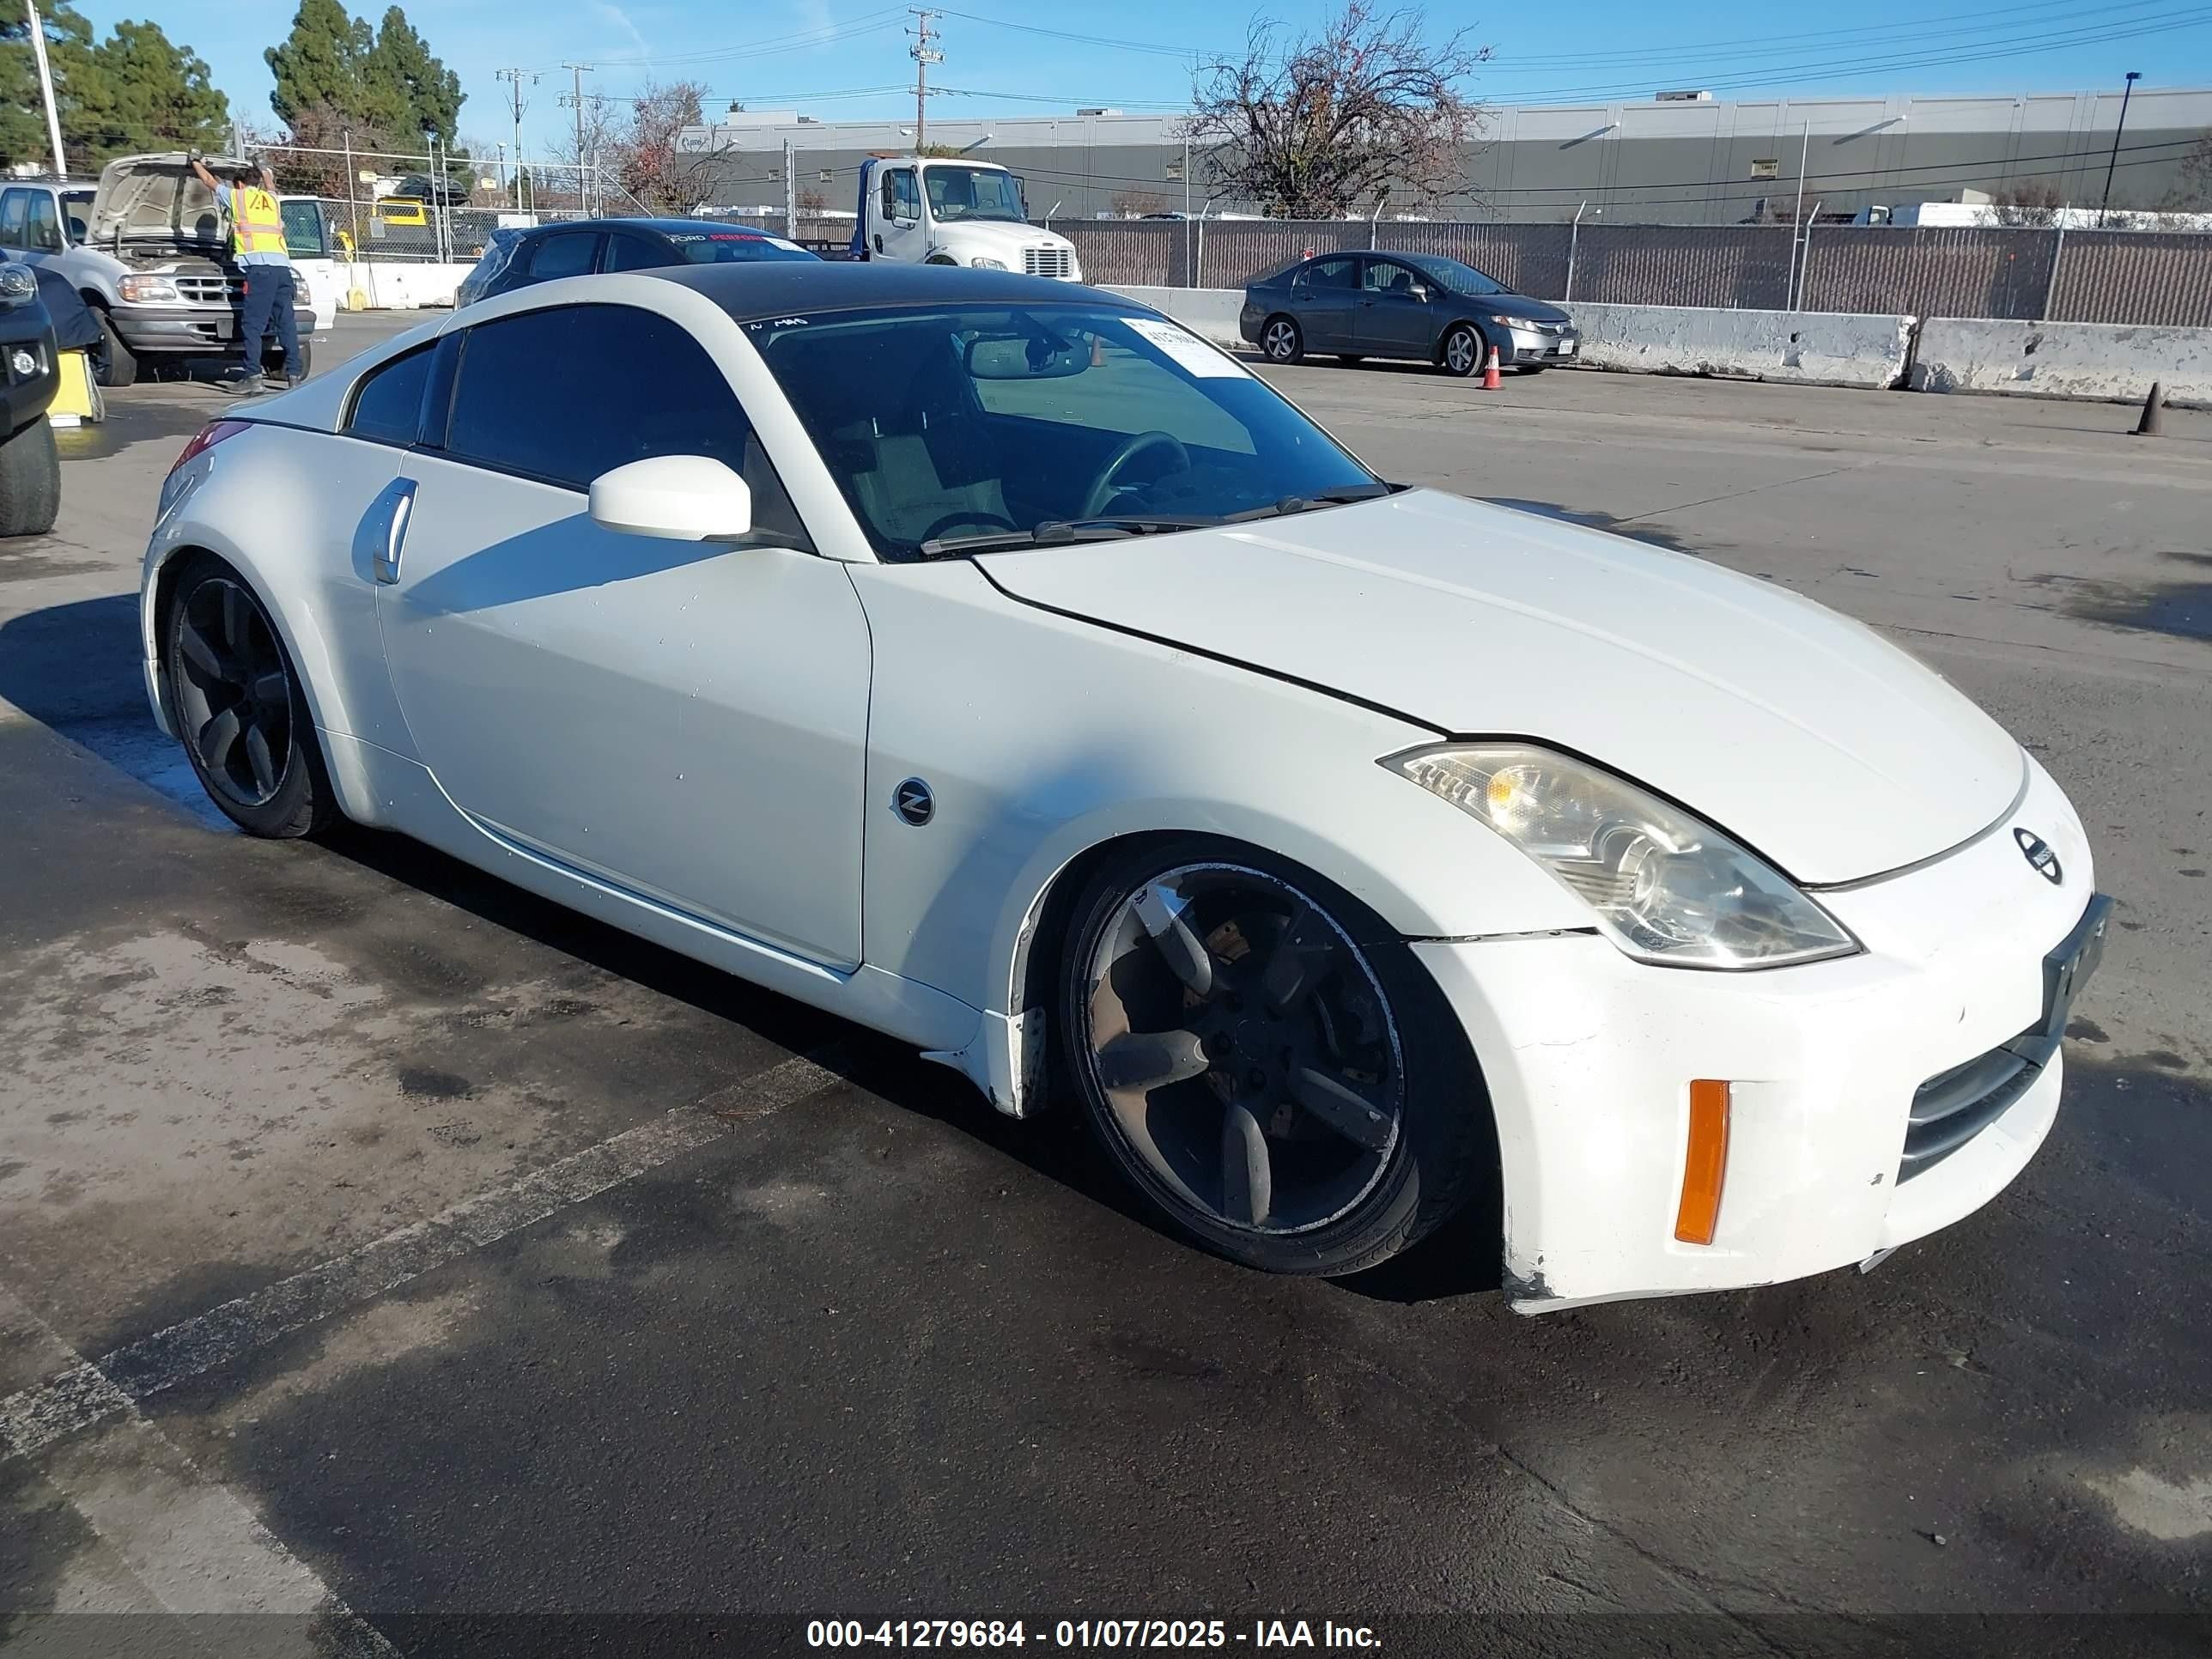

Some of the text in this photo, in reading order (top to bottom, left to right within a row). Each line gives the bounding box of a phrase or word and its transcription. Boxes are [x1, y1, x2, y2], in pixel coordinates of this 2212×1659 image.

[670, 234, 706, 244] FORD
[900, 791, 929, 814] Z
[2032, 845, 2054, 867] NISS
